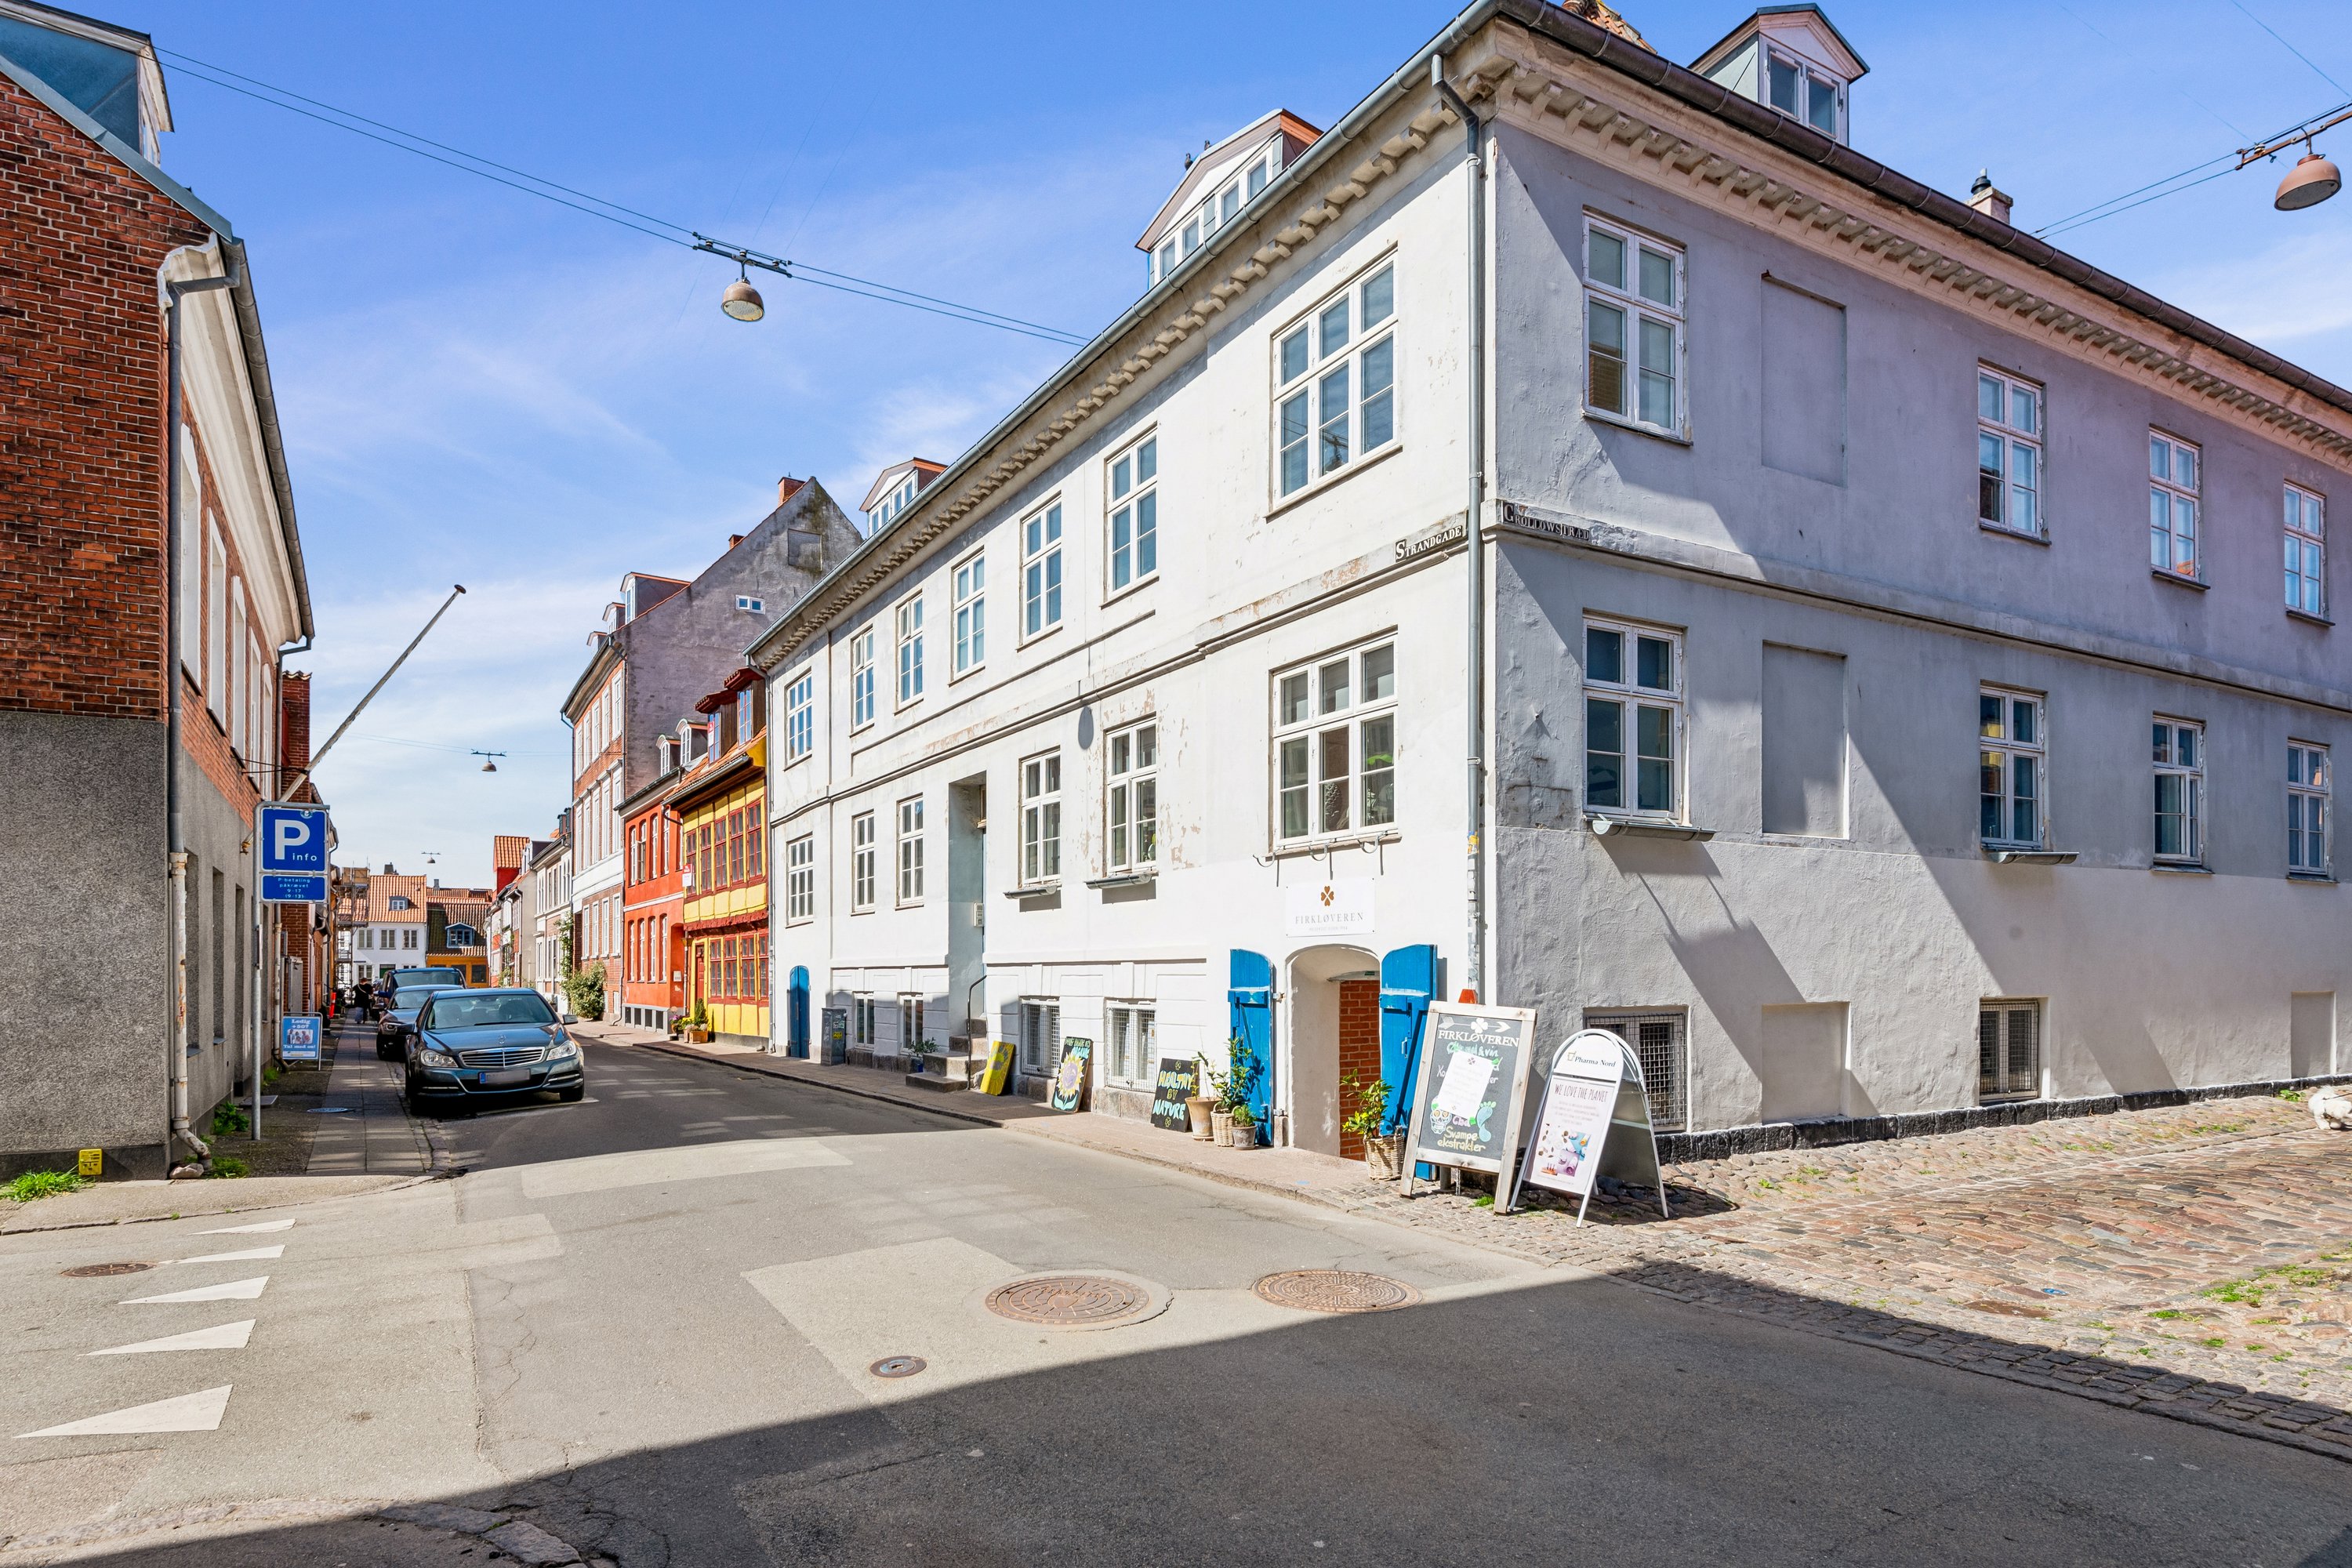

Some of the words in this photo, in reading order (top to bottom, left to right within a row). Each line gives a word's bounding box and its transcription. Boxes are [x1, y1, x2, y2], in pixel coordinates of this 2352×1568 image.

[1396, 526, 1462, 560] STRANDGADE
[274, 819, 310, 860] P
[292, 853, 317, 862] info
[1295, 912, 1363, 924] FIRKLØVEREN
[1438, 1029, 1519, 1047] FIRKLØVEREN
[1574, 1056, 1599, 1065] Pharma
[1158, 1070, 1194, 1091] HEALTHY
[1167, 1088, 1178, 1100] BY
[1555, 1083, 1563, 1096] WE
[1563, 1085, 1577, 1098] LOVE
[1577, 1087, 1588, 1100] THE
[1588, 1089, 1609, 1102] PLANET
[1152, 1098, 1186, 1121] NATURE
[1437, 1137, 1486, 1152] ekstrakter
